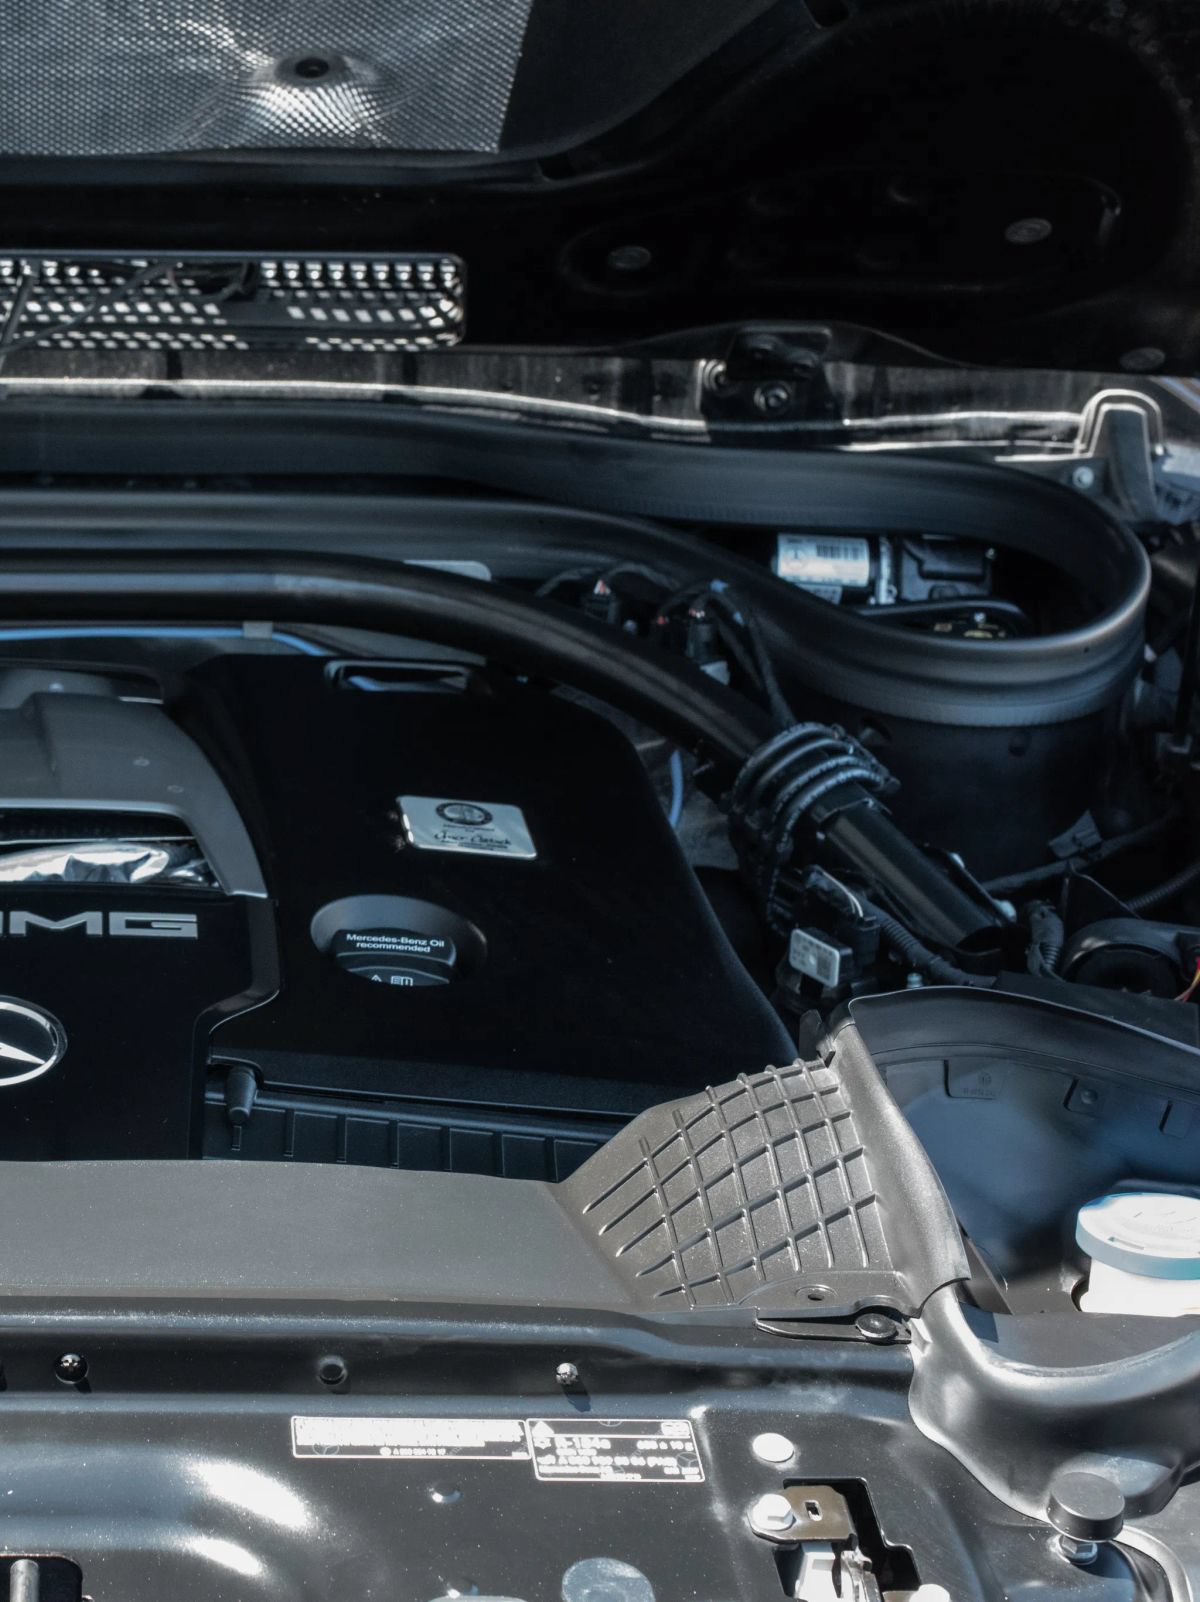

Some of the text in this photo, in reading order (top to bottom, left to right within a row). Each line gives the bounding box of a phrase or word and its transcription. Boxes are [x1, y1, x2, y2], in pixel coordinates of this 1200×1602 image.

[346, 933, 445, 947] Mercedes-Benz Oil
[356, 942, 431, 952] recommended
